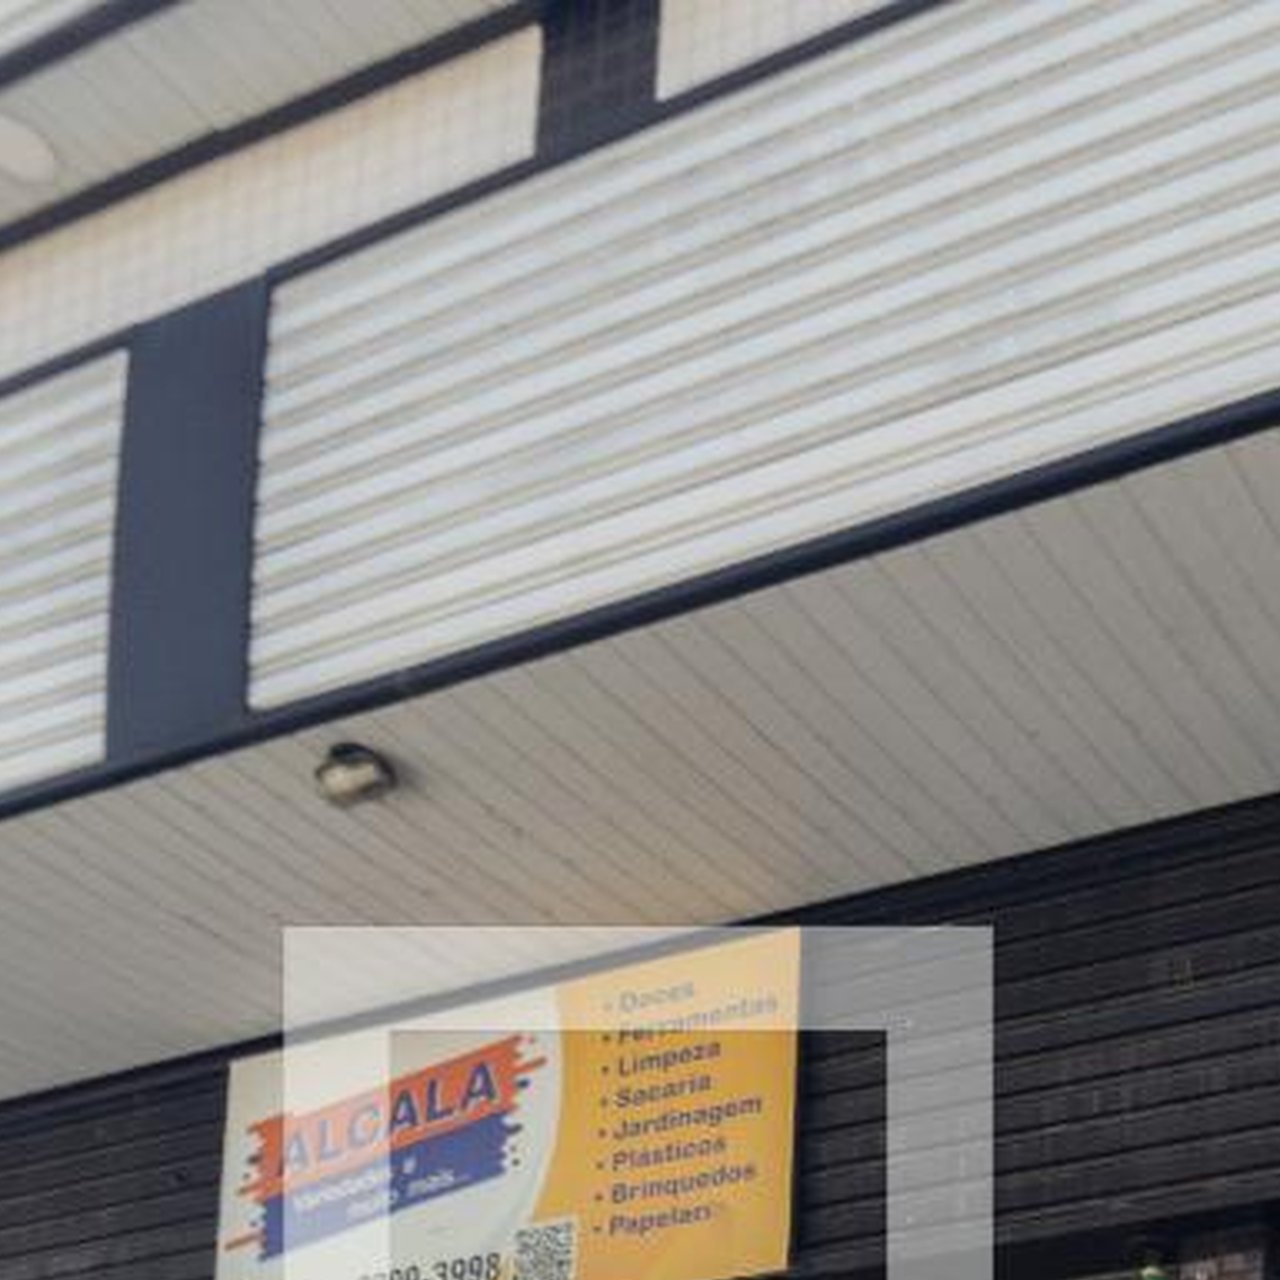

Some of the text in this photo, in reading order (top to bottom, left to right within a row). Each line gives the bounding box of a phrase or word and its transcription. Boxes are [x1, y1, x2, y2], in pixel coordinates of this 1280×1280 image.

[618, 1041, 722, 1077] Limpeza
[615, 1074, 712, 1108] Sacaria
[280, 1061, 498, 1174] ALCALA
[613, 1097, 763, 1139] Jardinagem
[611, 1163, 757, 1204] Brinquedos
